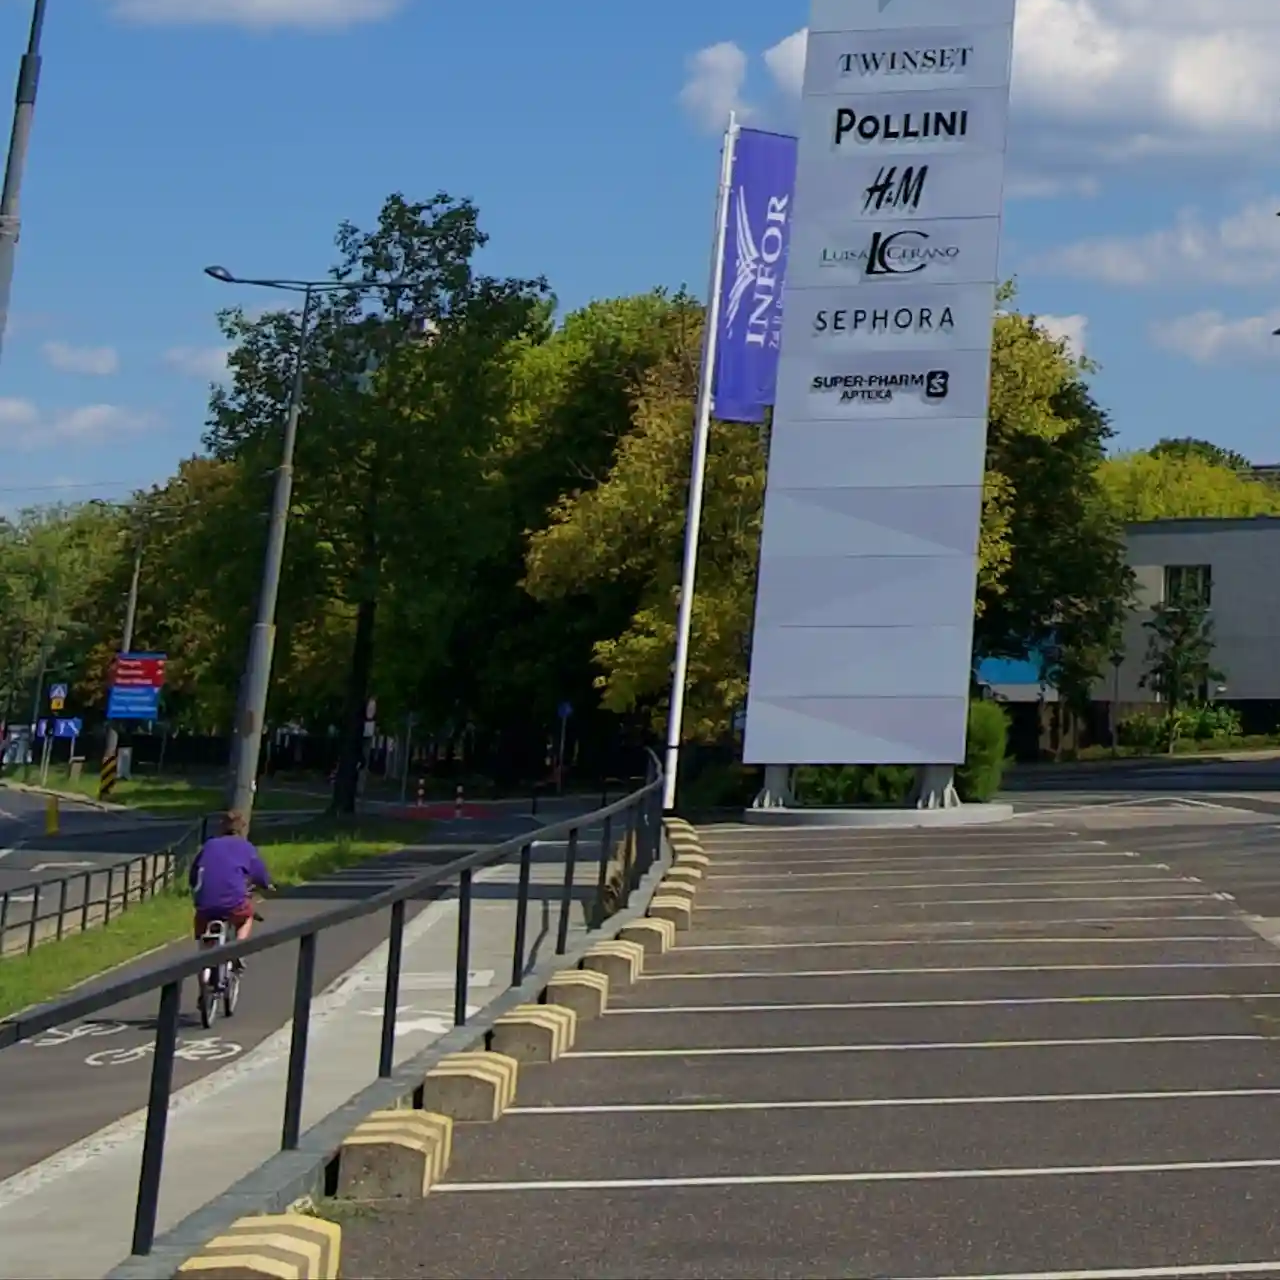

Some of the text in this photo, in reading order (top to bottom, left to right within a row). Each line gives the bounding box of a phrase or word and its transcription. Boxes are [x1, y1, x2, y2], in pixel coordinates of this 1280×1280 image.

[840, 46, 973, 73] TWINSET
[835, 108, 968, 144] POLLINI
[864, 165, 928, 210] H&M
[746, 194, 789, 349] INFOR
[815, 306, 954, 331] SEPHORA
[812, 374, 924, 389] SUPER-PHARM
